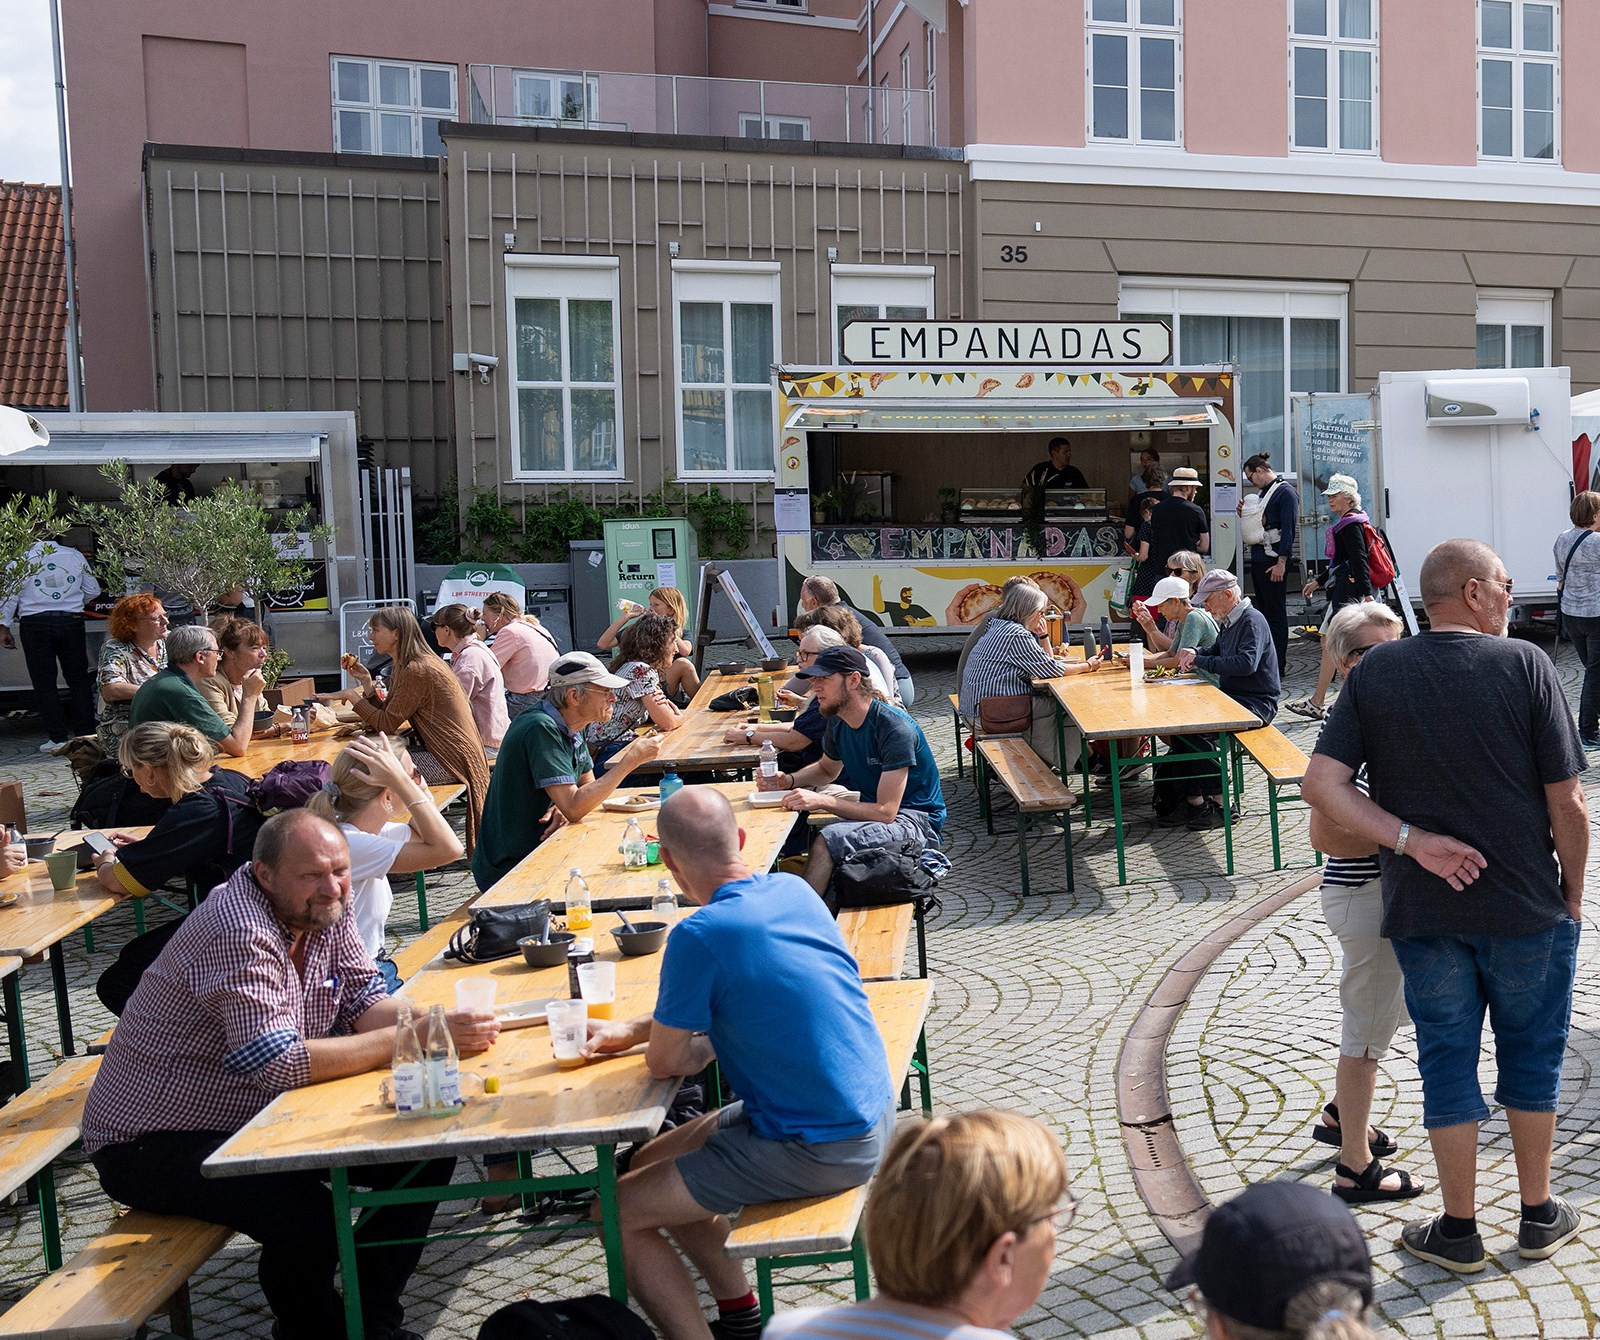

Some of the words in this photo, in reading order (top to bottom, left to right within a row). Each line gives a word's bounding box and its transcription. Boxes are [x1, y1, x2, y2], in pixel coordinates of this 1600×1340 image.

[1000, 244, 1029, 264] 35
[870, 326, 1142, 360] EMPANADAS
[1316, 431, 1343, 440] FESTEN
[1344, 435, 1366, 443] ELLER
[1337, 449, 1362, 458] PRIVAT
[1322, 455, 1355, 465] ERHVERV
[622, 522, 640, 530] idun
[879, 525, 1119, 560] EMPANADAS
[618, 573, 656, 581] Return
[618, 581, 643, 590] Here
